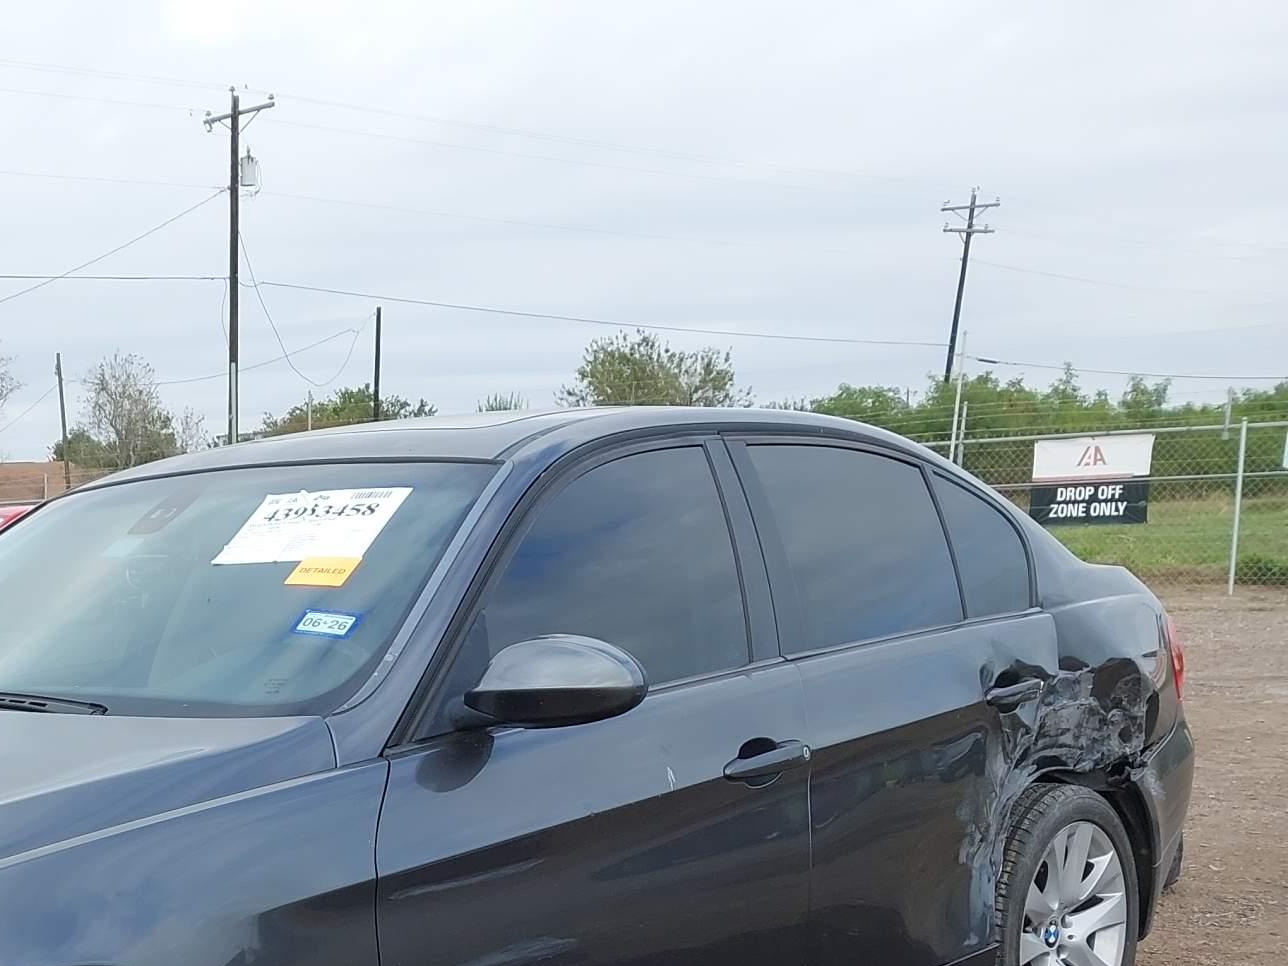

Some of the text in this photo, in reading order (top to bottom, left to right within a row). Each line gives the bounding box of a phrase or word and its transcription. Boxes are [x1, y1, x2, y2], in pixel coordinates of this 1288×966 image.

[1056, 485, 1123, 501] DROP OFF
[1049, 501, 1127, 518] ZONE ONLY
